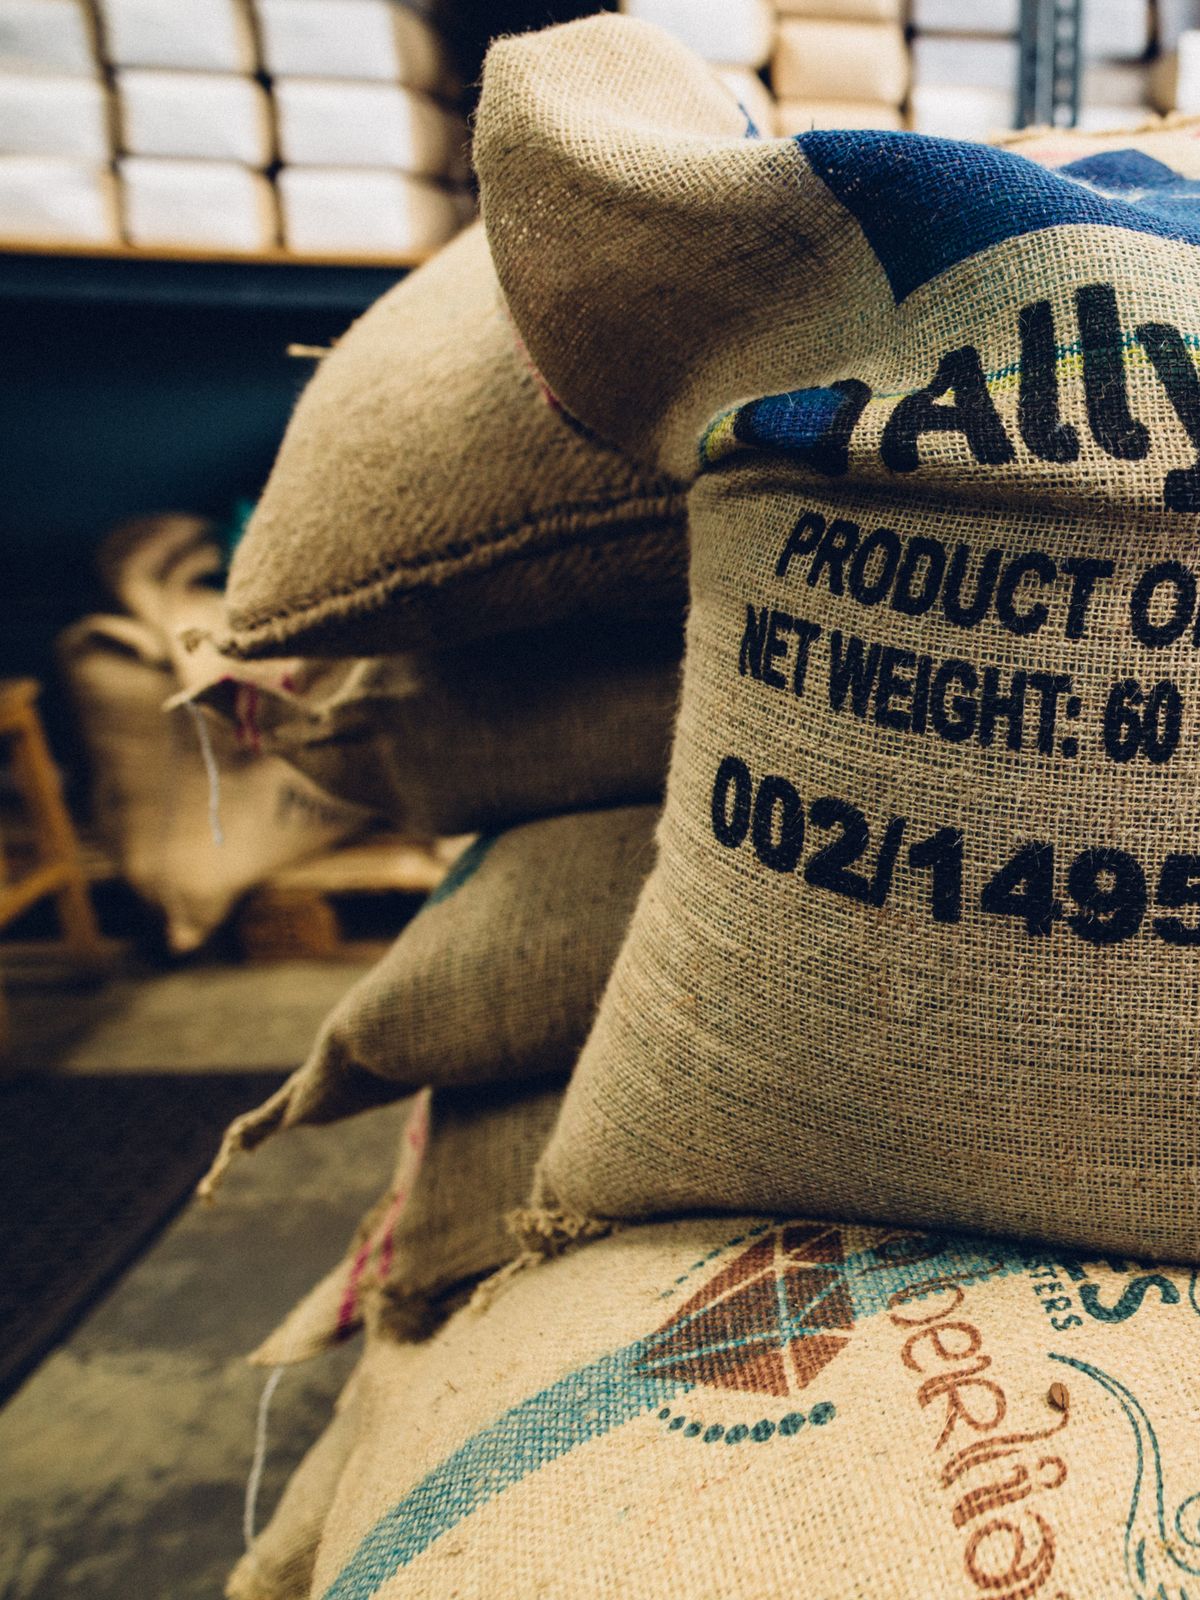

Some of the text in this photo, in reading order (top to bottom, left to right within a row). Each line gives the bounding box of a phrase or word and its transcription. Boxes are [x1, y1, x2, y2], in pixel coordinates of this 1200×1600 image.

[775, 512, 1113, 640] PRODUCT
[739, 603, 820, 697] NET
[829, 629, 1081, 758] WEIGHT:
[1103, 678, 1183, 764] 60
